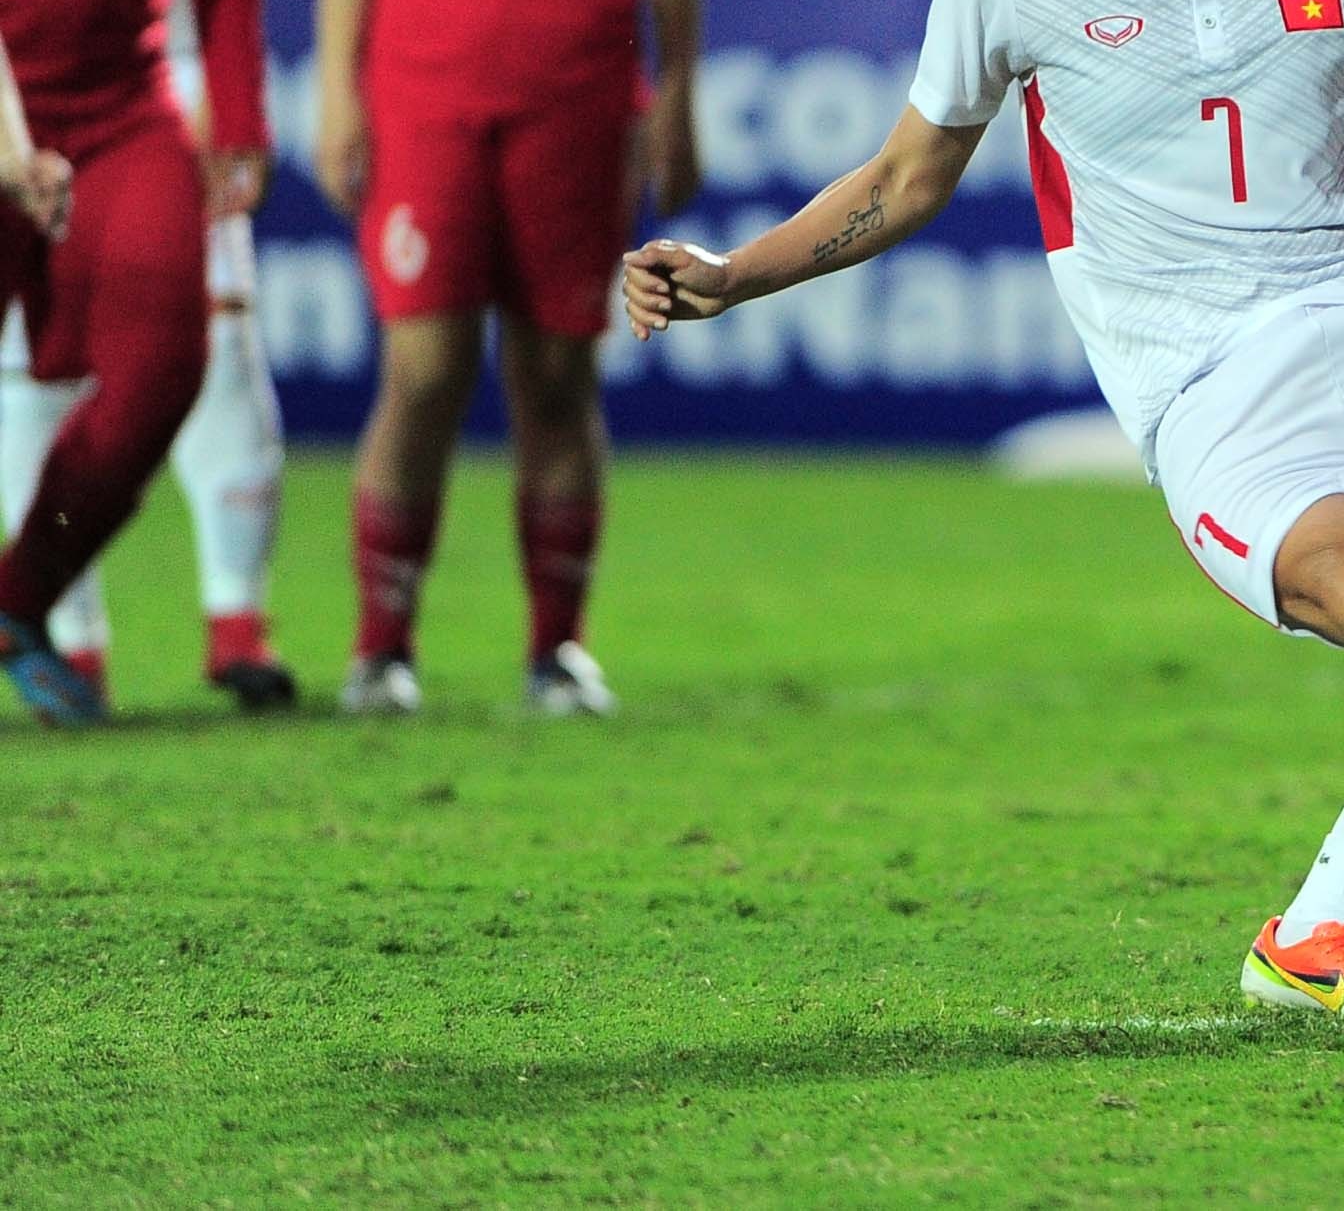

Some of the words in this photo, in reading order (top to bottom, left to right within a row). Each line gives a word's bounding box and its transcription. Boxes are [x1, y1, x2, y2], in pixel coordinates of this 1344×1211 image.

[1201, 97, 1248, 203] 7
[384, 203, 430, 284] 6
[1194, 512, 1249, 559] 7
